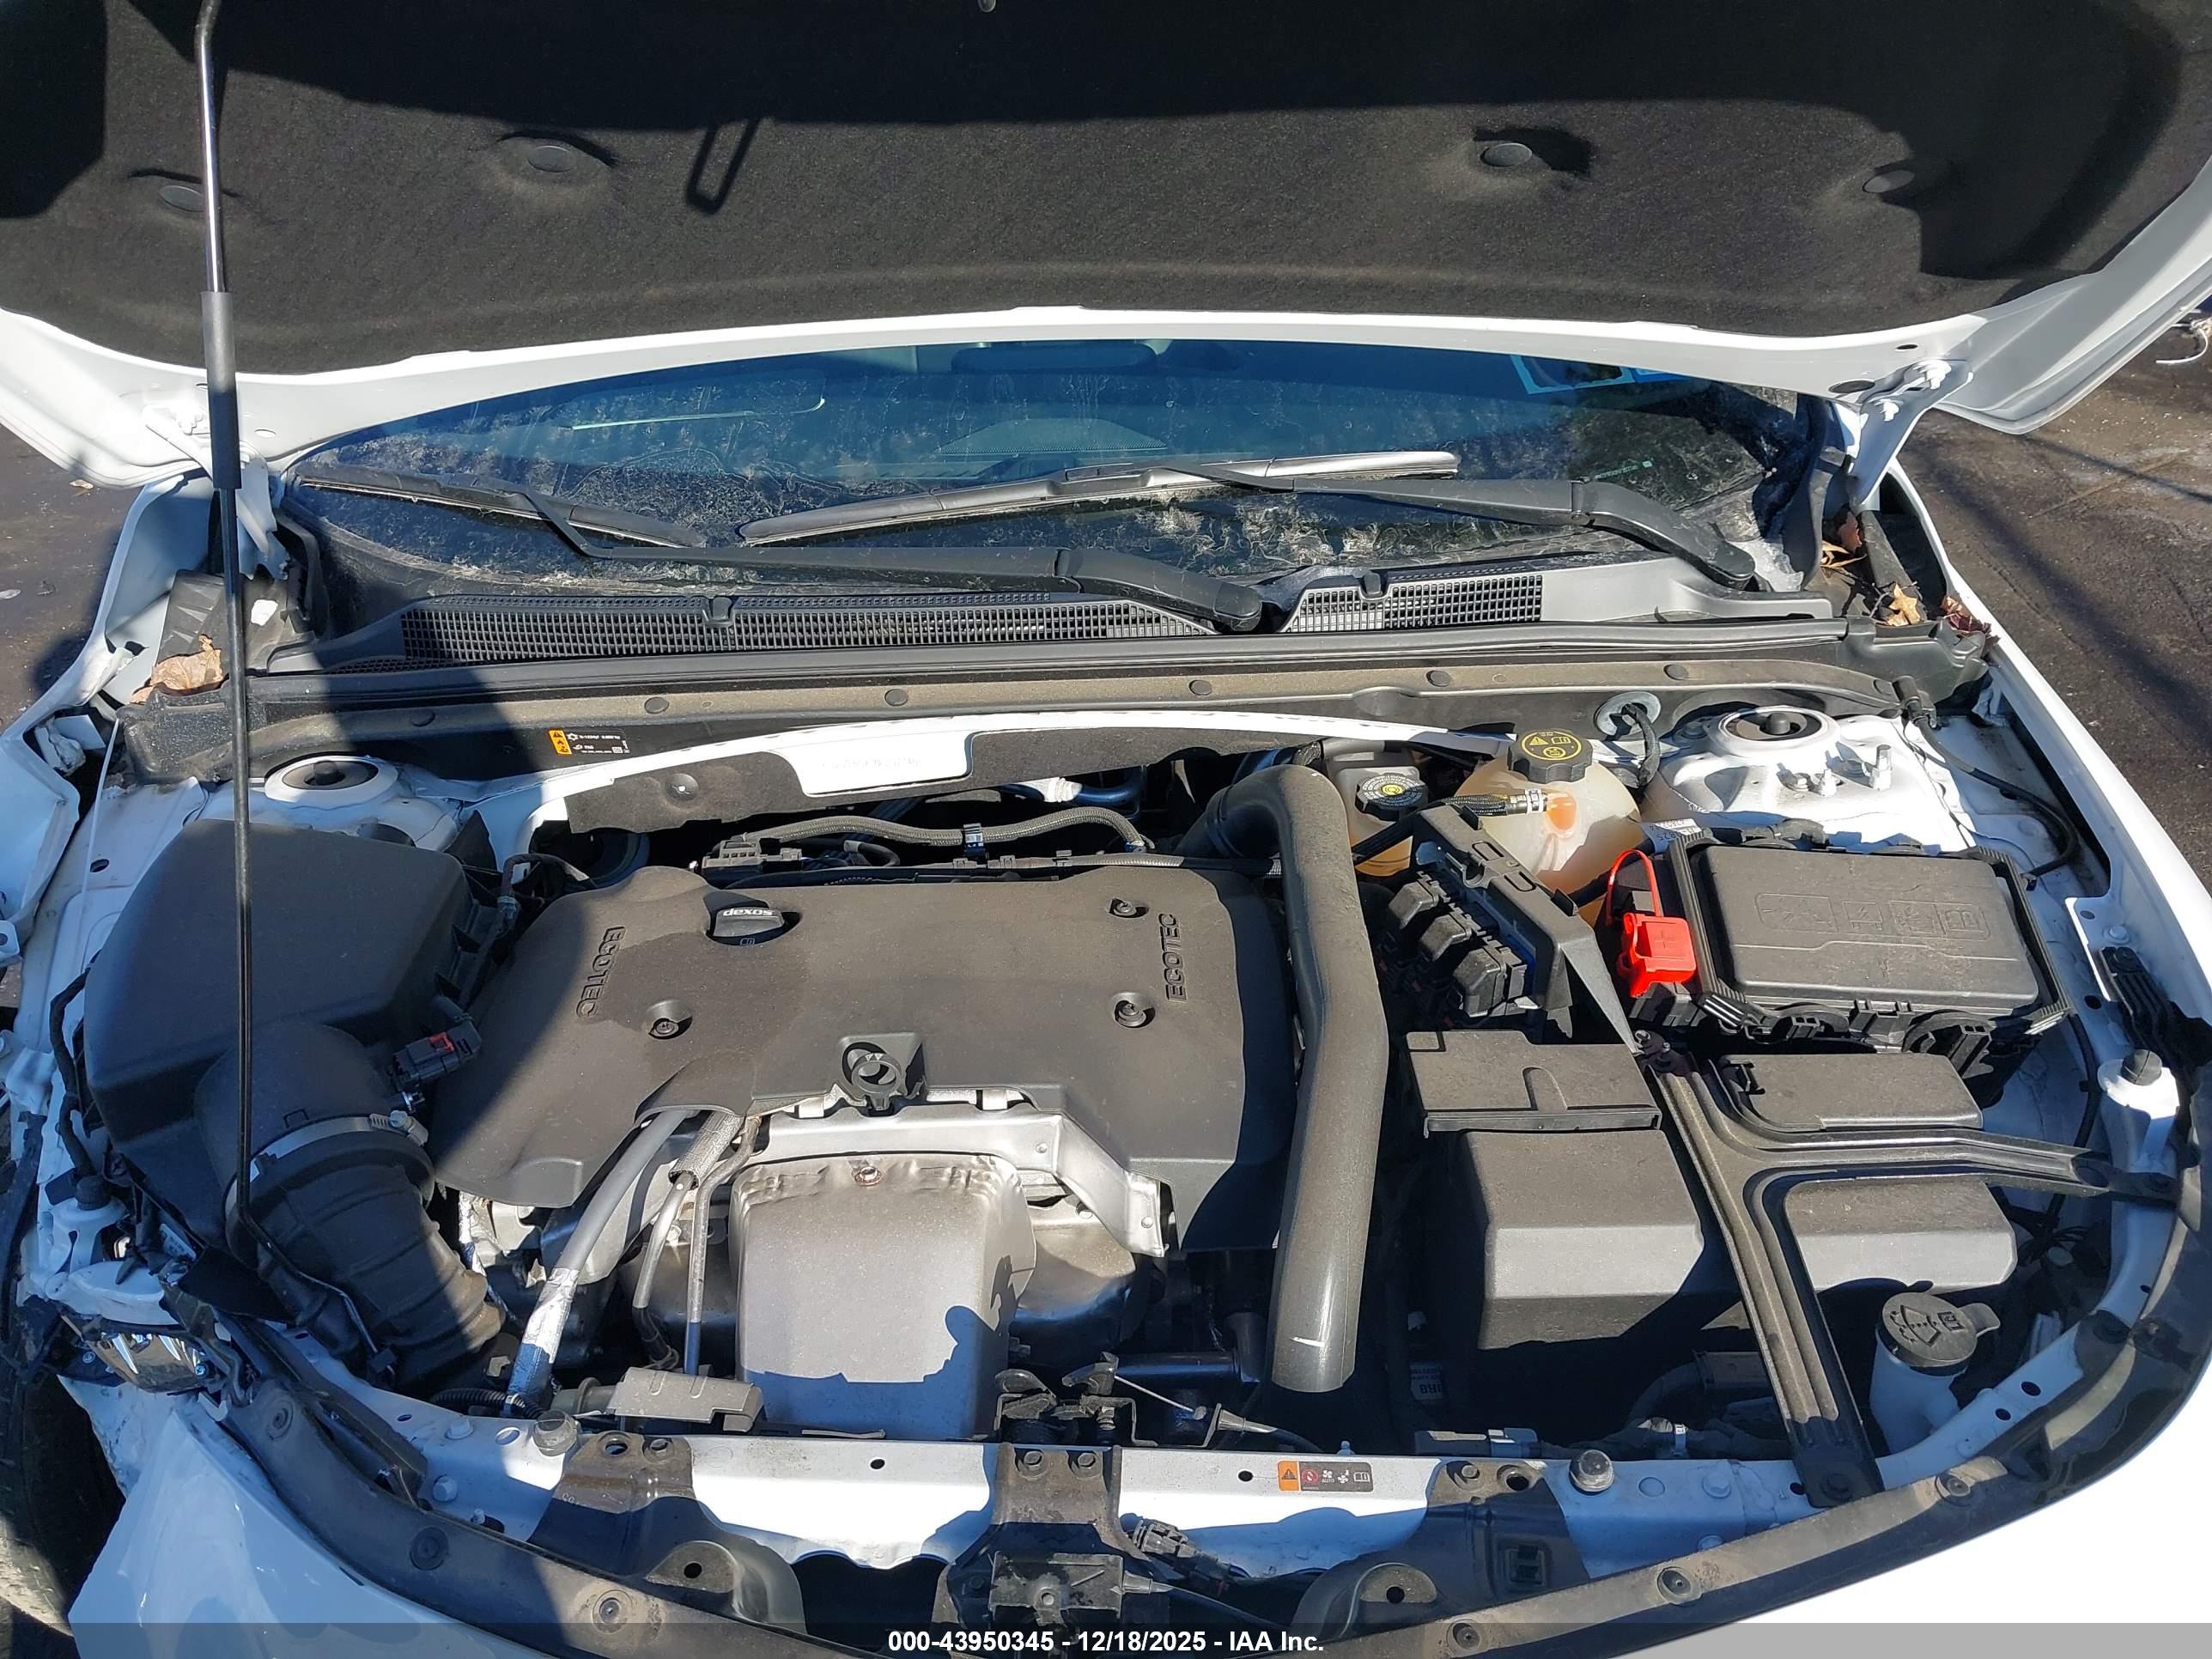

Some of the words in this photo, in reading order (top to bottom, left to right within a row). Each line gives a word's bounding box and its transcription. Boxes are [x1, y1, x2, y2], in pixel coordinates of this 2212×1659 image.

[722, 908, 773, 917] dexos
[575, 927, 625, 1017] ECOTEC
[1158, 914, 1187, 1002] ECOTEC
